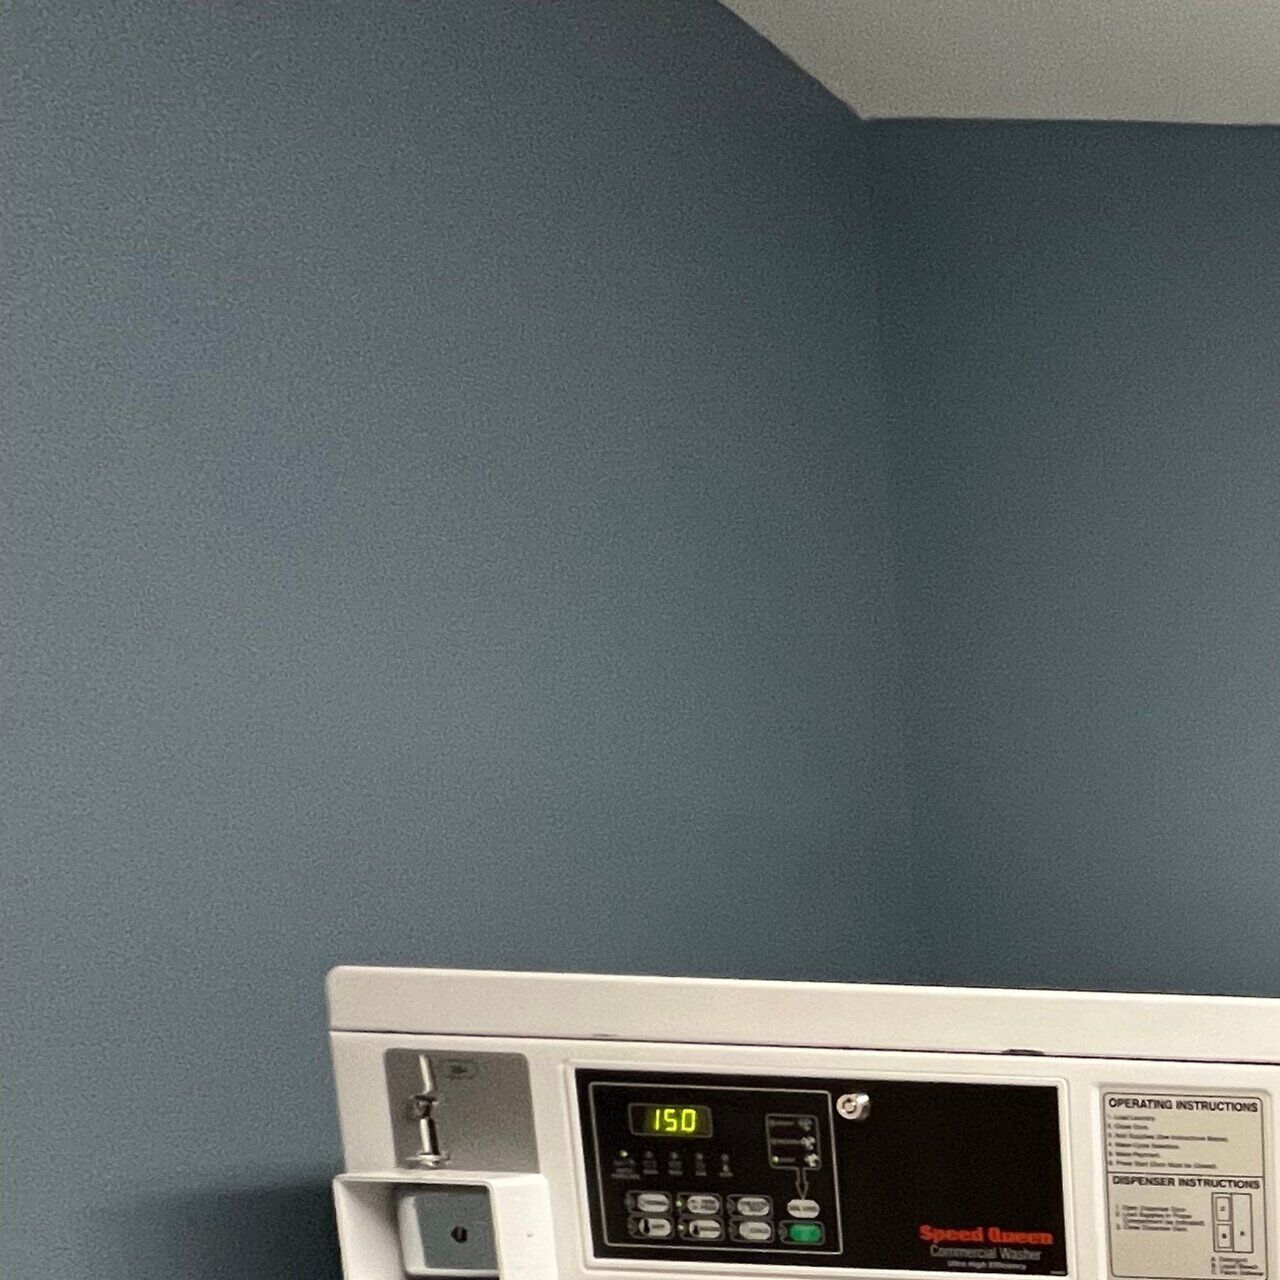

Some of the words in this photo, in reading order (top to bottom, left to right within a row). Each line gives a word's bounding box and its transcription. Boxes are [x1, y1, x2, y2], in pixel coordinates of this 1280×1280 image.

[1109, 1098, 1172, 1109] OPERATING
[1176, 1099, 1258, 1112] INSTRUCTIONS
[654, 1108, 696, 1133] 150
[1113, 1176, 1175, 1186] DISPENSER
[1178, 1177, 1260, 1189] INSTRUCTIONS
[919, 1224, 983, 1244] Speed
[988, 1227, 1053, 1245] Queen
[930, 1244, 997, 1259] Commercial
[1001, 1248, 1042, 1260] Washer
